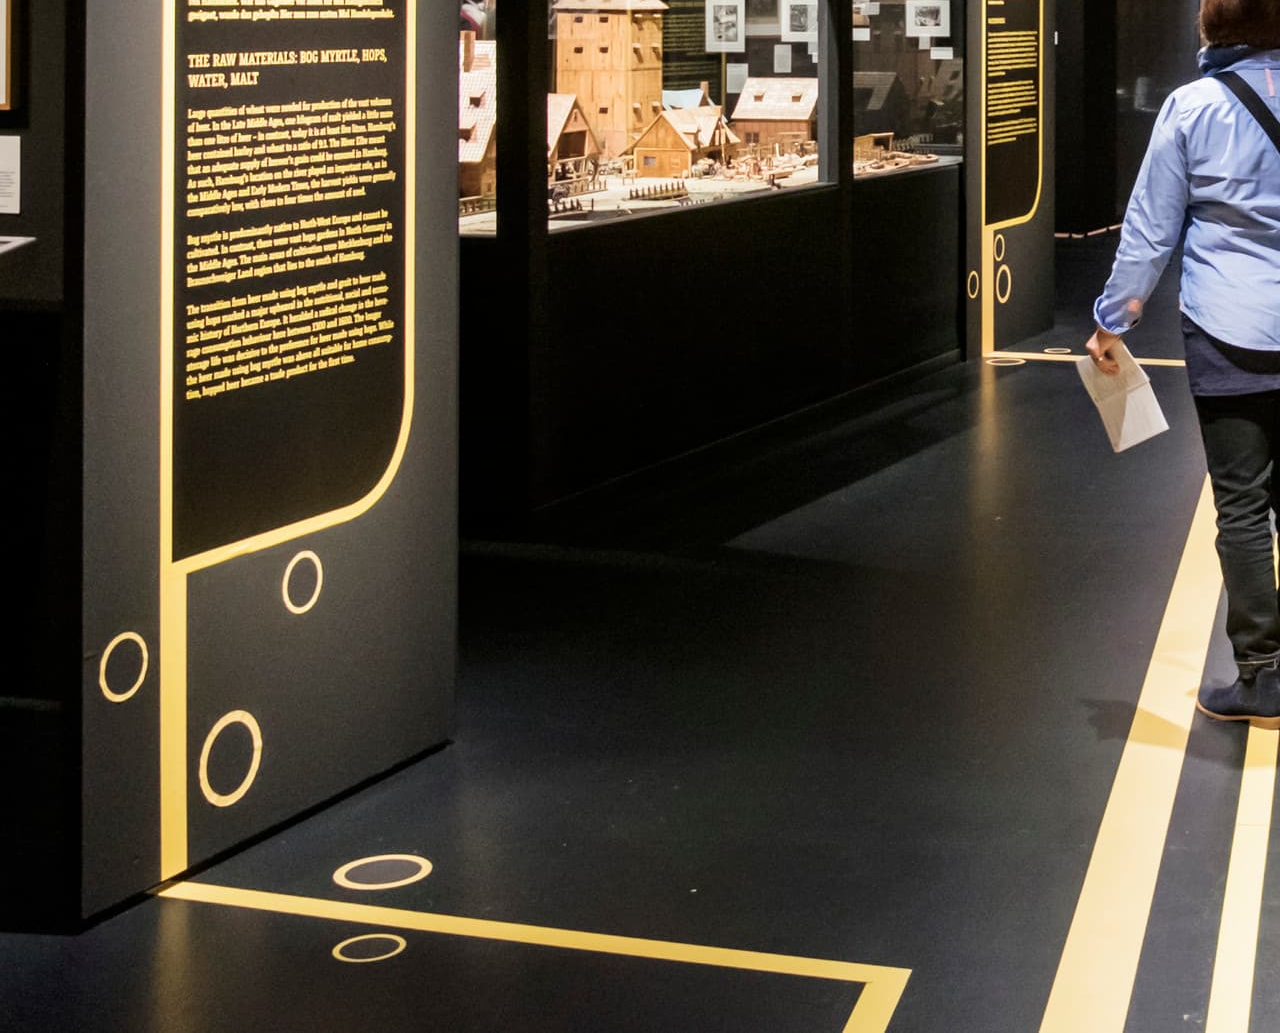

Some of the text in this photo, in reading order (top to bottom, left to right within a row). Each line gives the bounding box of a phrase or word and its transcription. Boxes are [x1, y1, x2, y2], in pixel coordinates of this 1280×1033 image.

[188, 48, 387, 68] THE RAW MATERIALS: BOG MYRTLE, HOPS,
[188, 71, 259, 88] WATER, MALT
